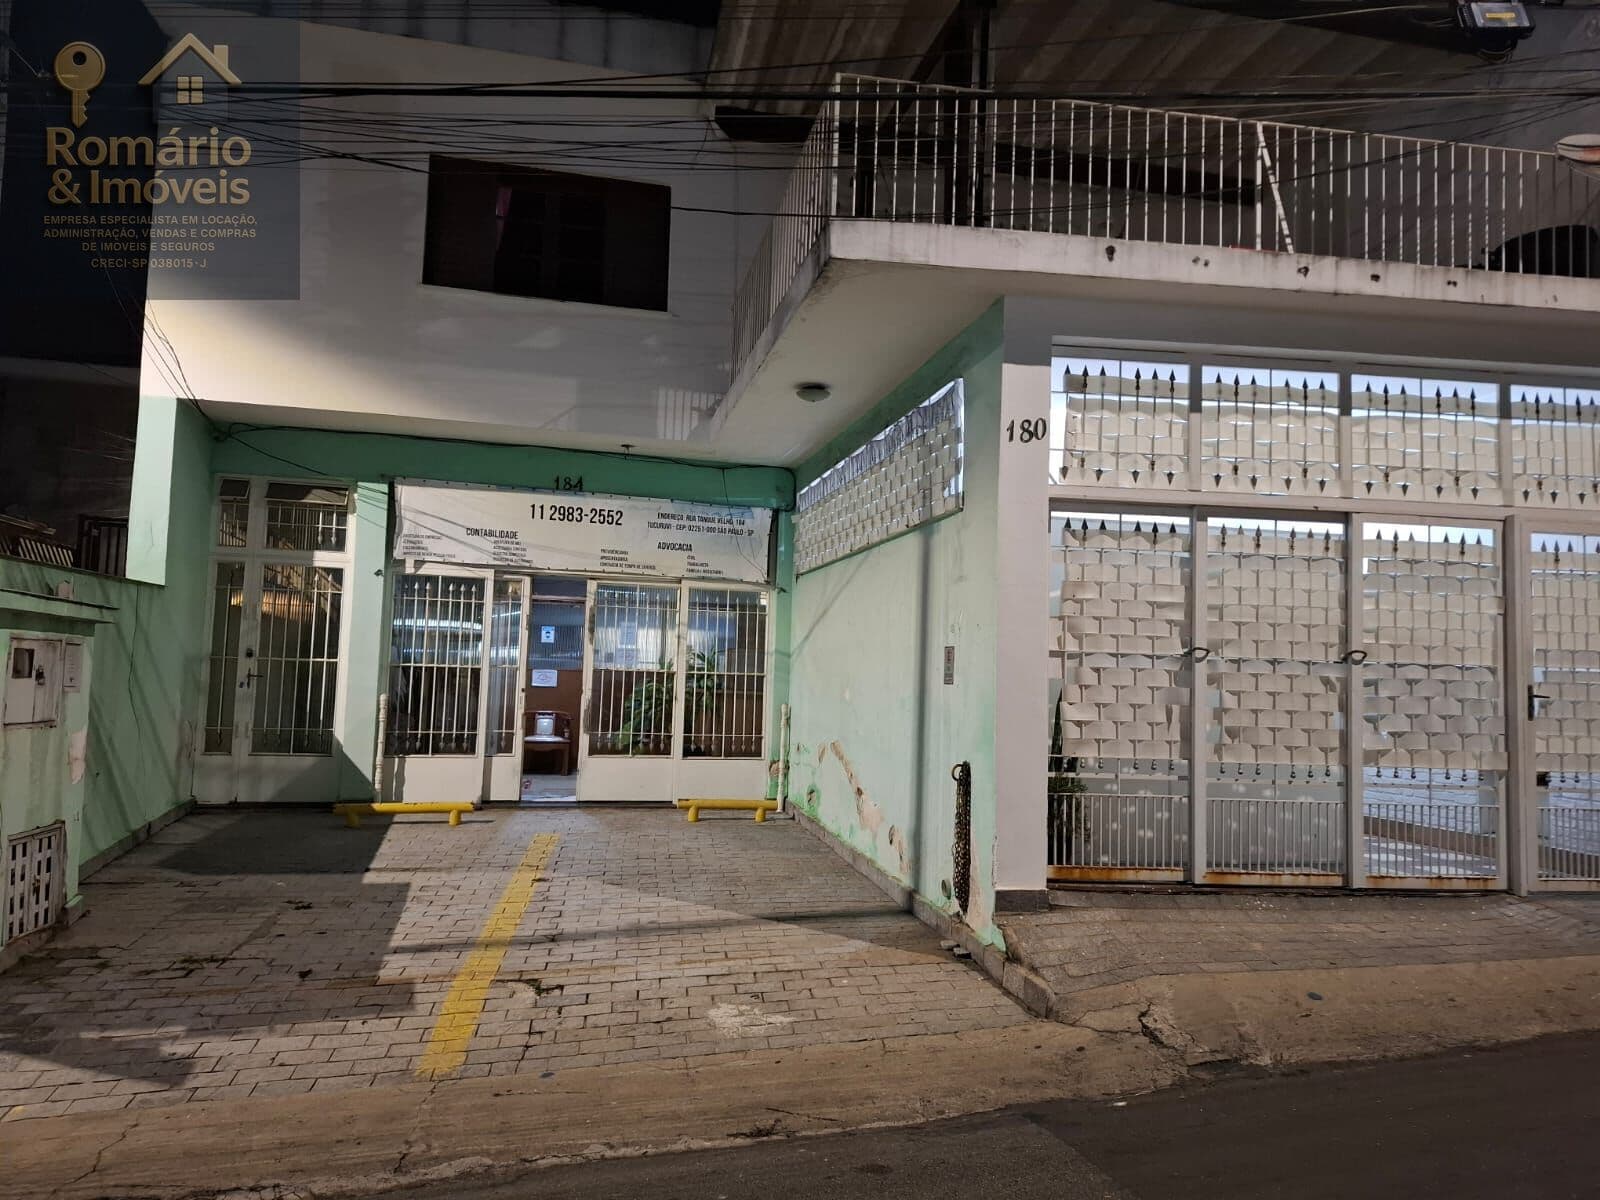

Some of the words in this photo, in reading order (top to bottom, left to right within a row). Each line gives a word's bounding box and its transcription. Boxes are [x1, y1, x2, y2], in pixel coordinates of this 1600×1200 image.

[1006, 417, 1047, 444] 180
[554, 475, 584, 492] 184
[530, 503, 544, 520] 11
[549, 504, 624, 526] 2983-2552
[465, 527, 519, 540] CONTABILIDADE
[657, 541, 693, 552] ADVOCACIA
